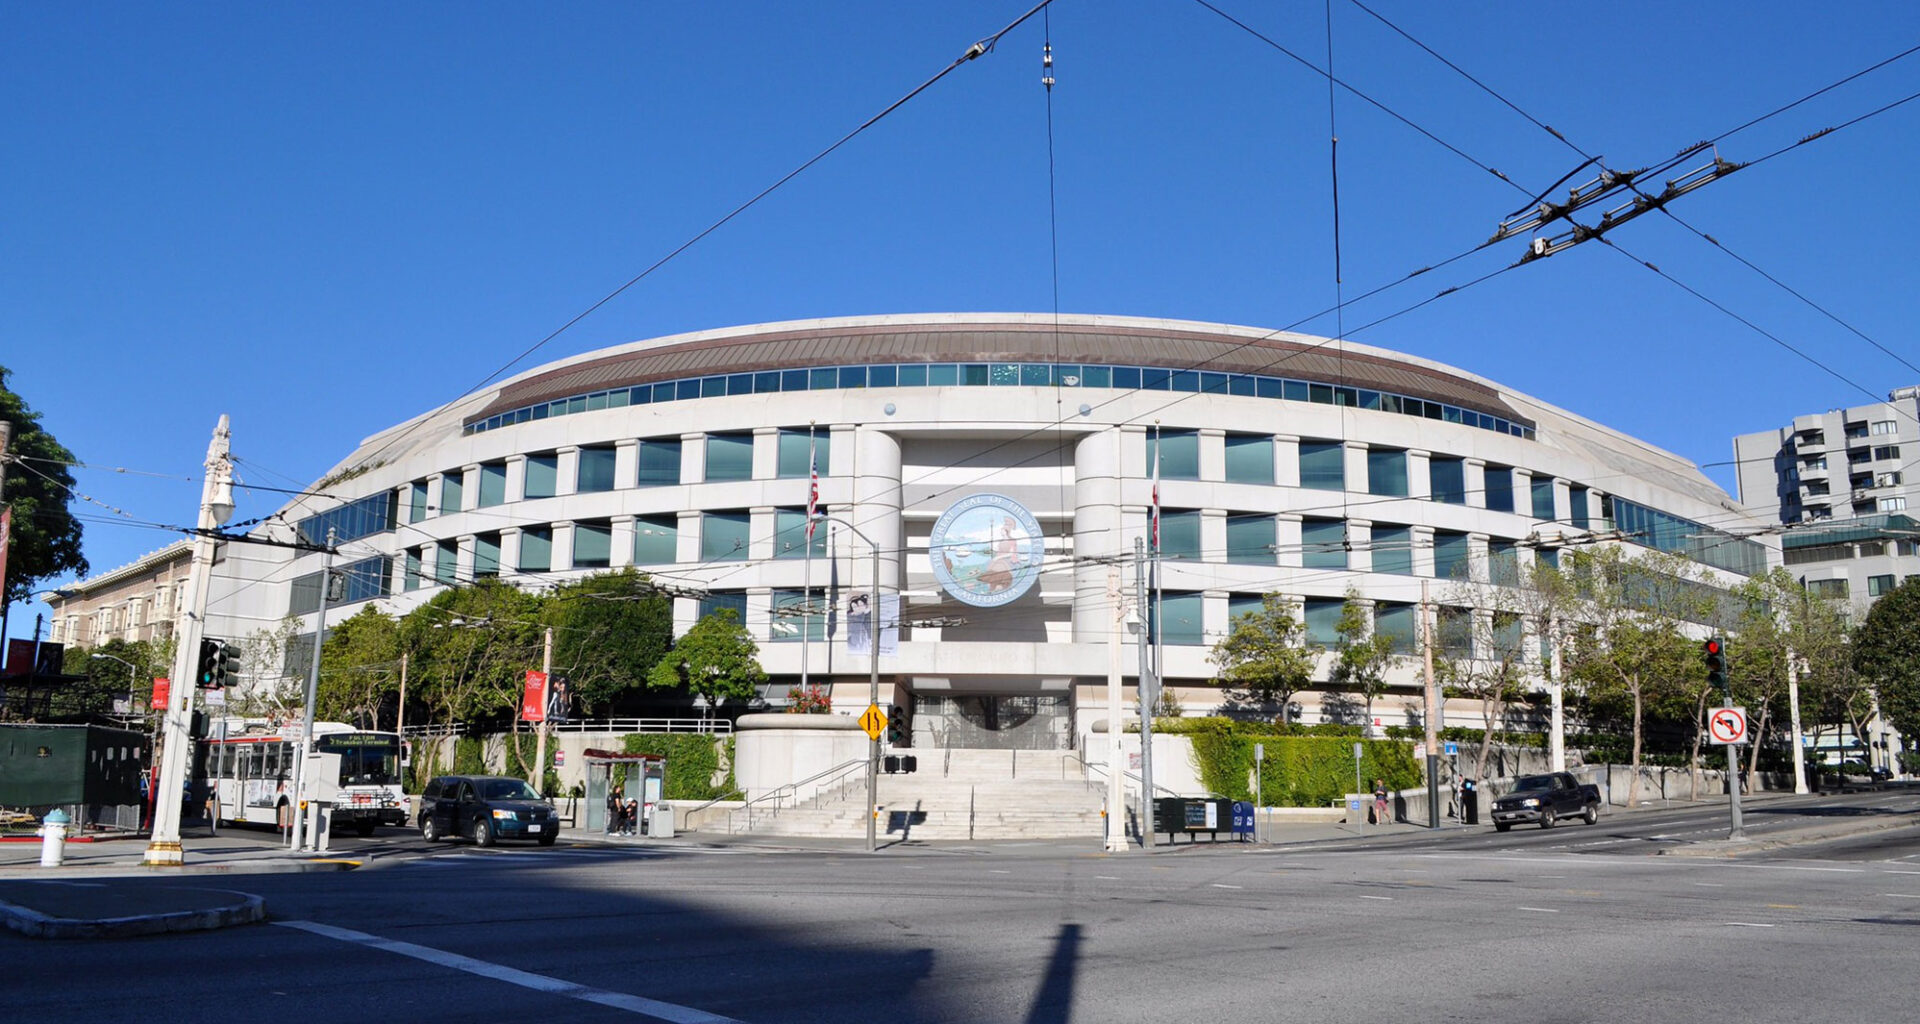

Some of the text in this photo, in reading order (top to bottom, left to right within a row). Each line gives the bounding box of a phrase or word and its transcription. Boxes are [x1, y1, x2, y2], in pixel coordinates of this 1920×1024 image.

[933, 512, 956, 544] GREAT
[959, 496, 982, 510] SEAL
[989, 496, 1004, 504] OF
[1009, 501, 1026, 518] THE
[954, 588, 1018, 602] CALIFORNIA
